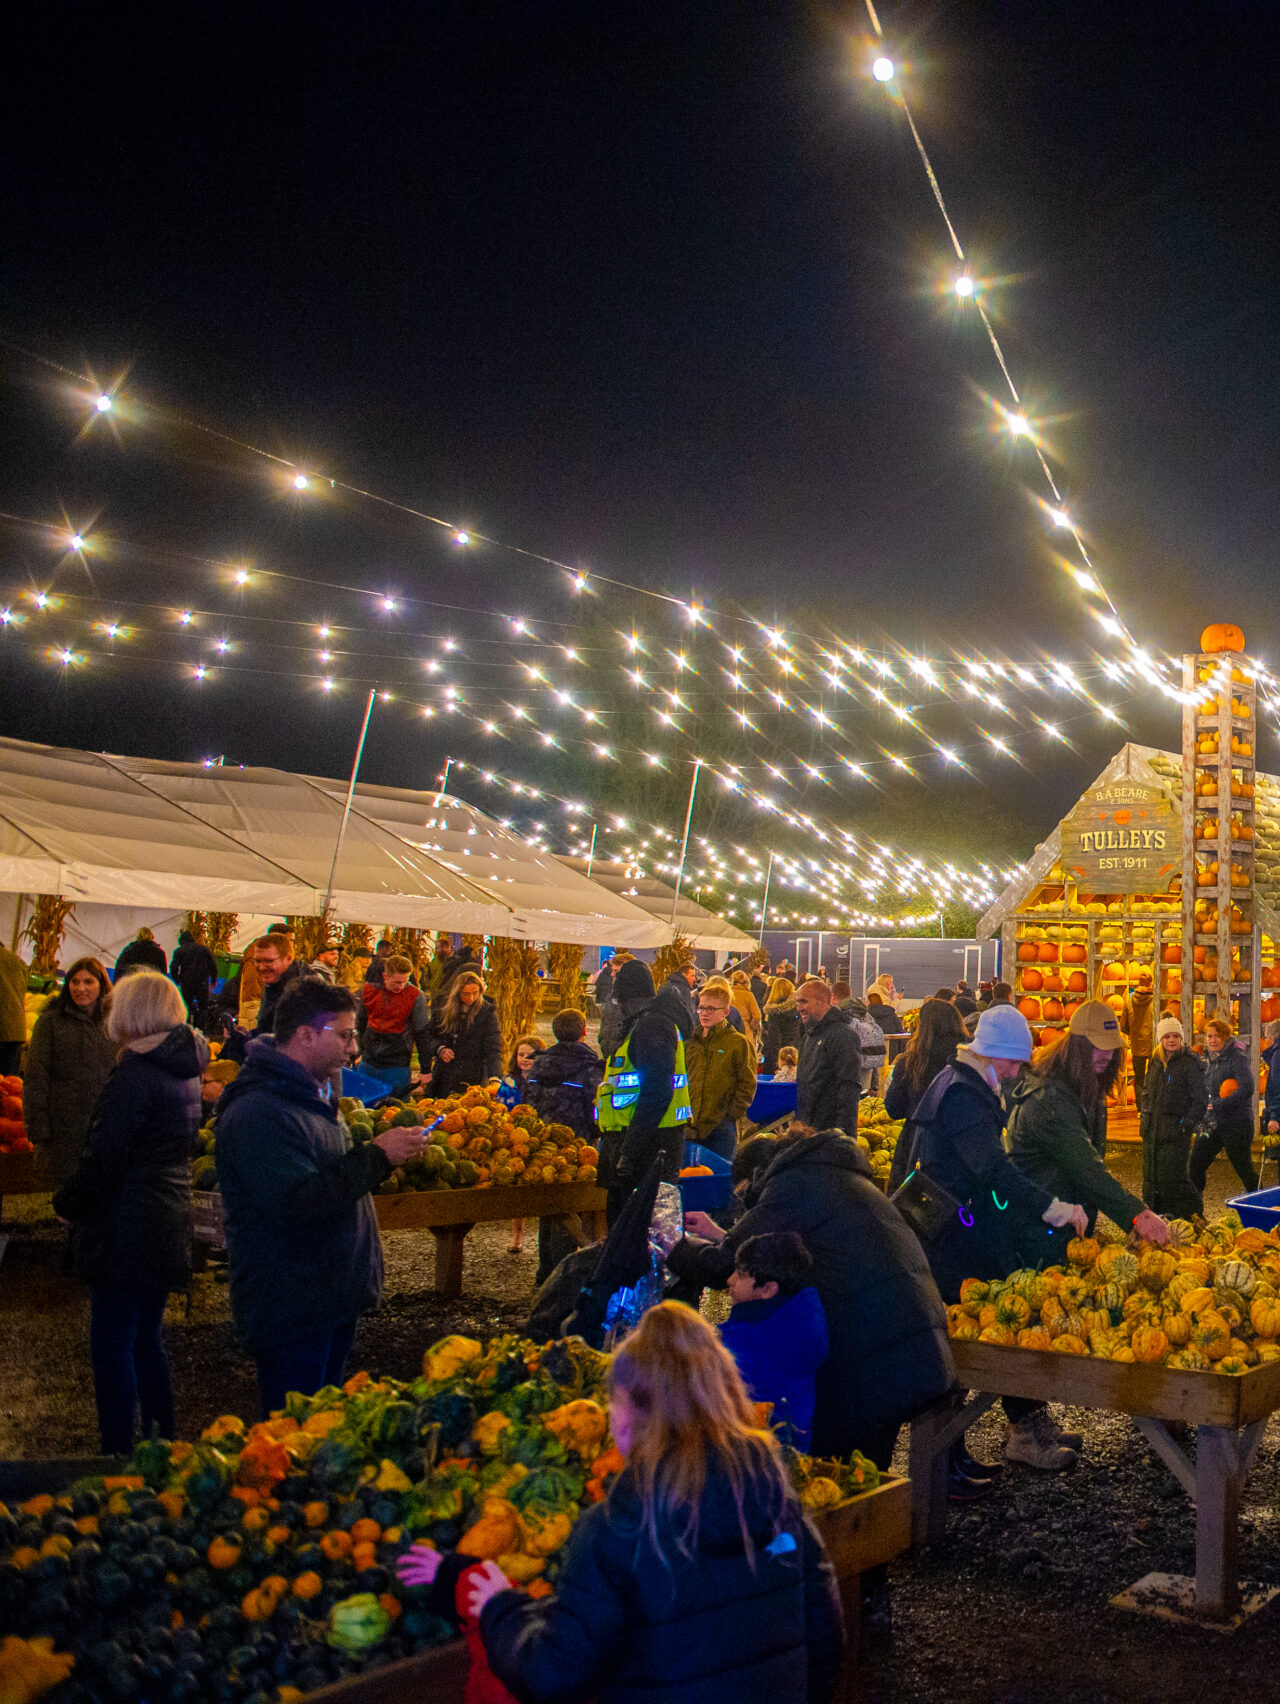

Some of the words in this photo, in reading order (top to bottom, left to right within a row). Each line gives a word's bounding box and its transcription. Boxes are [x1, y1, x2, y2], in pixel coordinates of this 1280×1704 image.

[1117, 797, 1134, 805] SONS
[1080, 829, 1166, 852] TULLEYS
[1099, 857, 1121, 869] EST.
[1122, 857, 1147, 868] 1911
